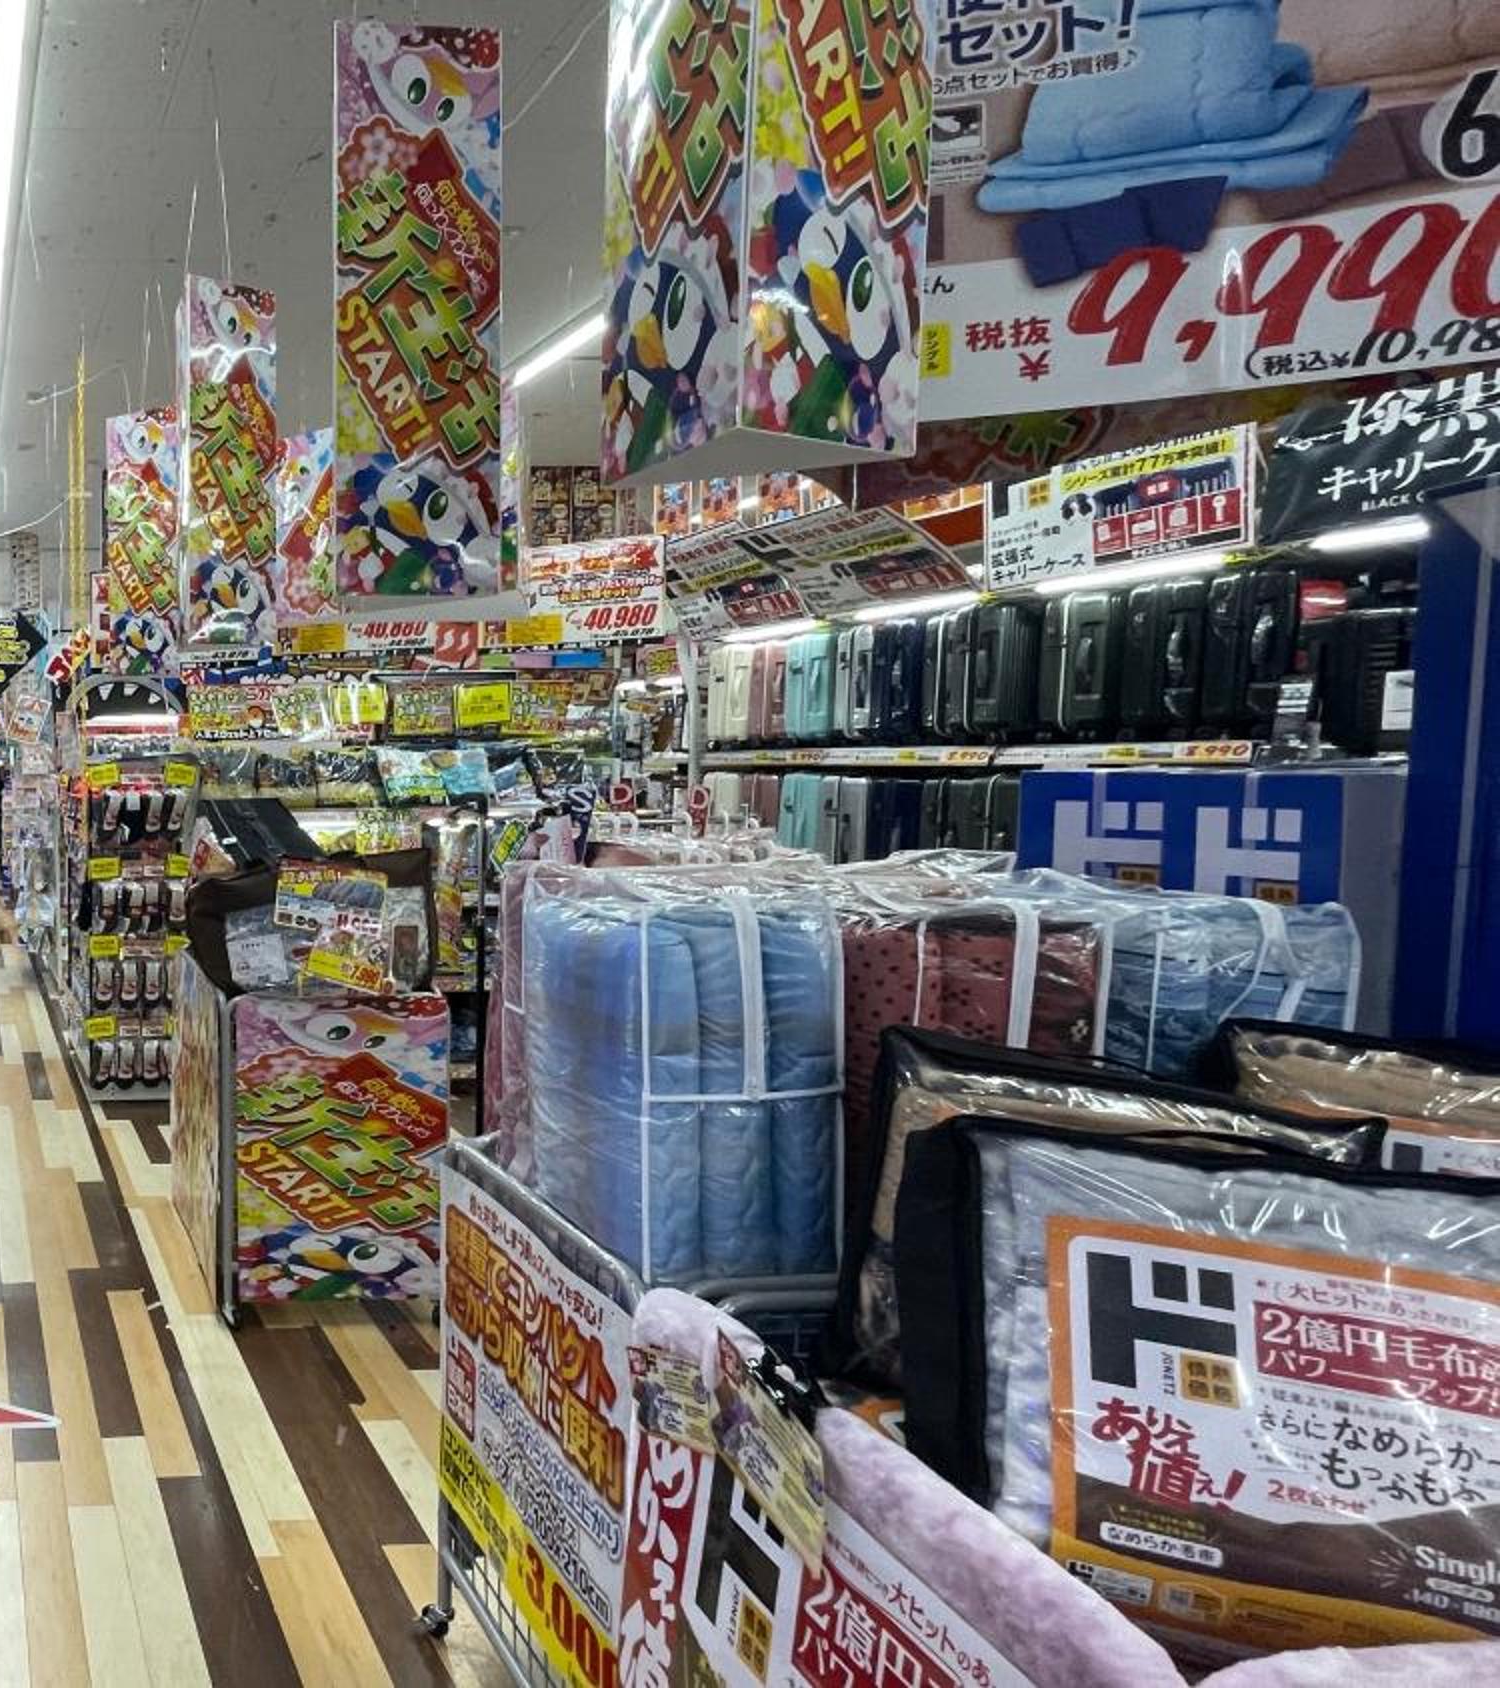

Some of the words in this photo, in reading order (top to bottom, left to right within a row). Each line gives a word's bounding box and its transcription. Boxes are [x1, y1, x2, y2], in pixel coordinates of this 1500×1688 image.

[966, 318, 1051, 352] 税抜
[337, 296, 434, 449] START!
[1018, 350, 1052, 381] ¥
[1361, 493, 1411, 512] BLACK
[583, 603, 658, 631] 40,980
[238, 1140, 358, 1226] START!
[1416, 1545, 1500, 1586] Singl
